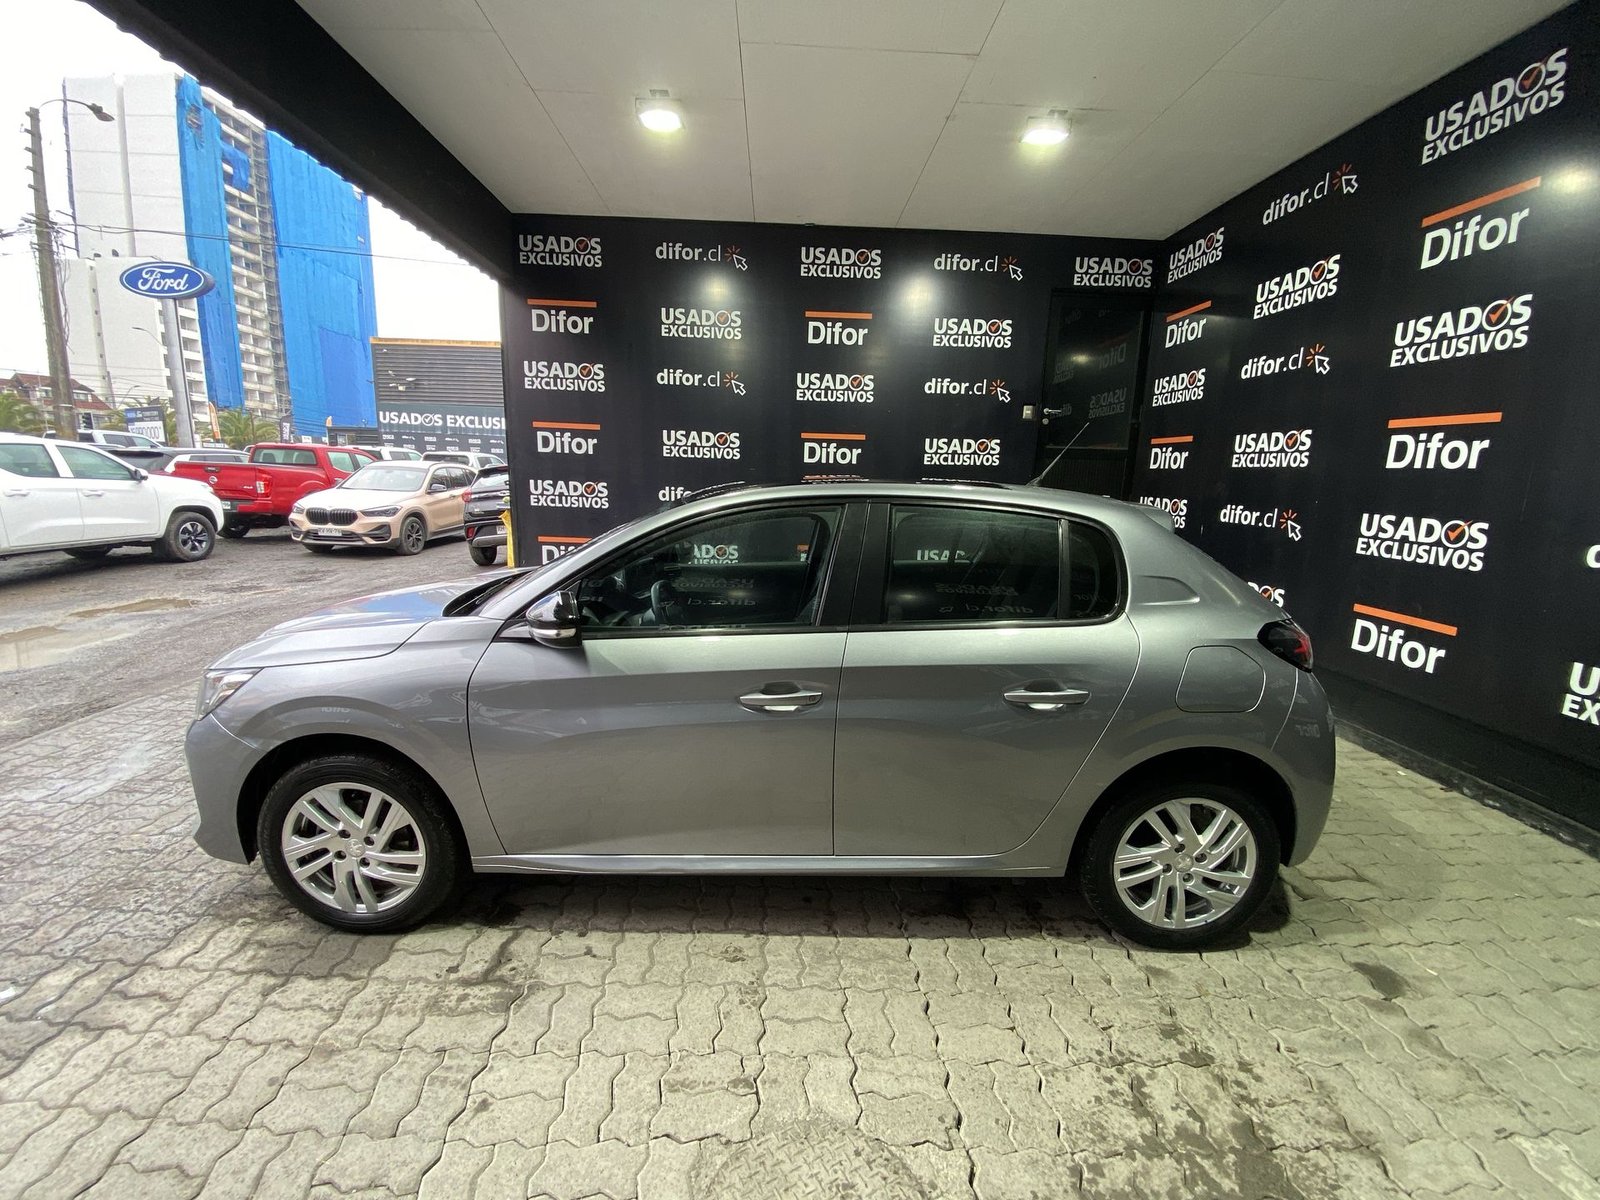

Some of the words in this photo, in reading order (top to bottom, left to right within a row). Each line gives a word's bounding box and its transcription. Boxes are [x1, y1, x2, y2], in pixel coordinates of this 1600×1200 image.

[1424, 47, 1568, 142] USADOS
[1421, 80, 1566, 166] EXCLUSIVOS
[1262, 172, 1330, 226] difor.cl
[518, 234, 602, 255] USADOS
[1169, 226, 1225, 270] USADOS
[1420, 208, 1530, 271] Difor
[519, 252, 602, 268] EXCLUSIVOS
[655, 242, 721, 262] difor.cl
[800, 246, 882, 267] USADOS
[800, 264, 881, 280] EXCLUSIVOS
[933, 254, 998, 272] difor.cl
[1075, 256, 1153, 276] USADOS
[1167, 246, 1223, 284] EXCLUSIVOS
[137, 267, 189, 291] Ford
[1073, 273, 1152, 288] EXCLUSIVOS
[1256, 254, 1341, 303] USADOS
[1253, 278, 1338, 320] EXCLUSIVOS
[531, 309, 594, 334] Difor
[661, 307, 742, 328] USADOS
[934, 317, 1013, 336] USADOS
[1394, 293, 1533, 347] USADOS
[661, 324, 742, 340] EXCLUSIVOS
[807, 321, 868, 346] Difor
[932, 333, 1012, 349] EXCLUSIVOS
[1165, 317, 1207, 348] Difor
[1390, 325, 1529, 368] EXCLUSIVOS
[523, 360, 605, 380] USADOS
[1240, 347, 1305, 380] difor.cl
[524, 377, 606, 393] EXCLUSIVOS
[656, 369, 720, 387] difor.cl
[796, 372, 874, 390] USADOS
[924, 378, 987, 396] difor.cl
[1154, 368, 1206, 394] USADOS
[796, 387, 874, 403] EXCLUSIVOS
[1152, 385, 1204, 407] EXCLUSIVOS
[379, 411, 443, 426] USADOS
[536, 431, 598, 455] Difor
[662, 429, 740, 448] USADOS
[924, 437, 1001, 455] USADOS
[1234, 429, 1313, 453] USADOS
[662, 445, 741, 460] EXCLUSIVOS
[802, 441, 862, 464] Difor
[923, 452, 1000, 467] EXCLUSIVOS
[1149, 447, 1189, 470] Difor
[1231, 451, 1310, 468] EXCLUSIVOS
[1385, 432, 1490, 470] Difor
[529, 479, 609, 498] USADOS
[530, 495, 609, 509] EXCLUSIVOS
[1219, 504, 1278, 528] difor.cl
[1359, 513, 1489, 550] USADOS
[1355, 536, 1485, 572] EXCLUSIVOS
[1350, 618, 1446, 675] Difor
